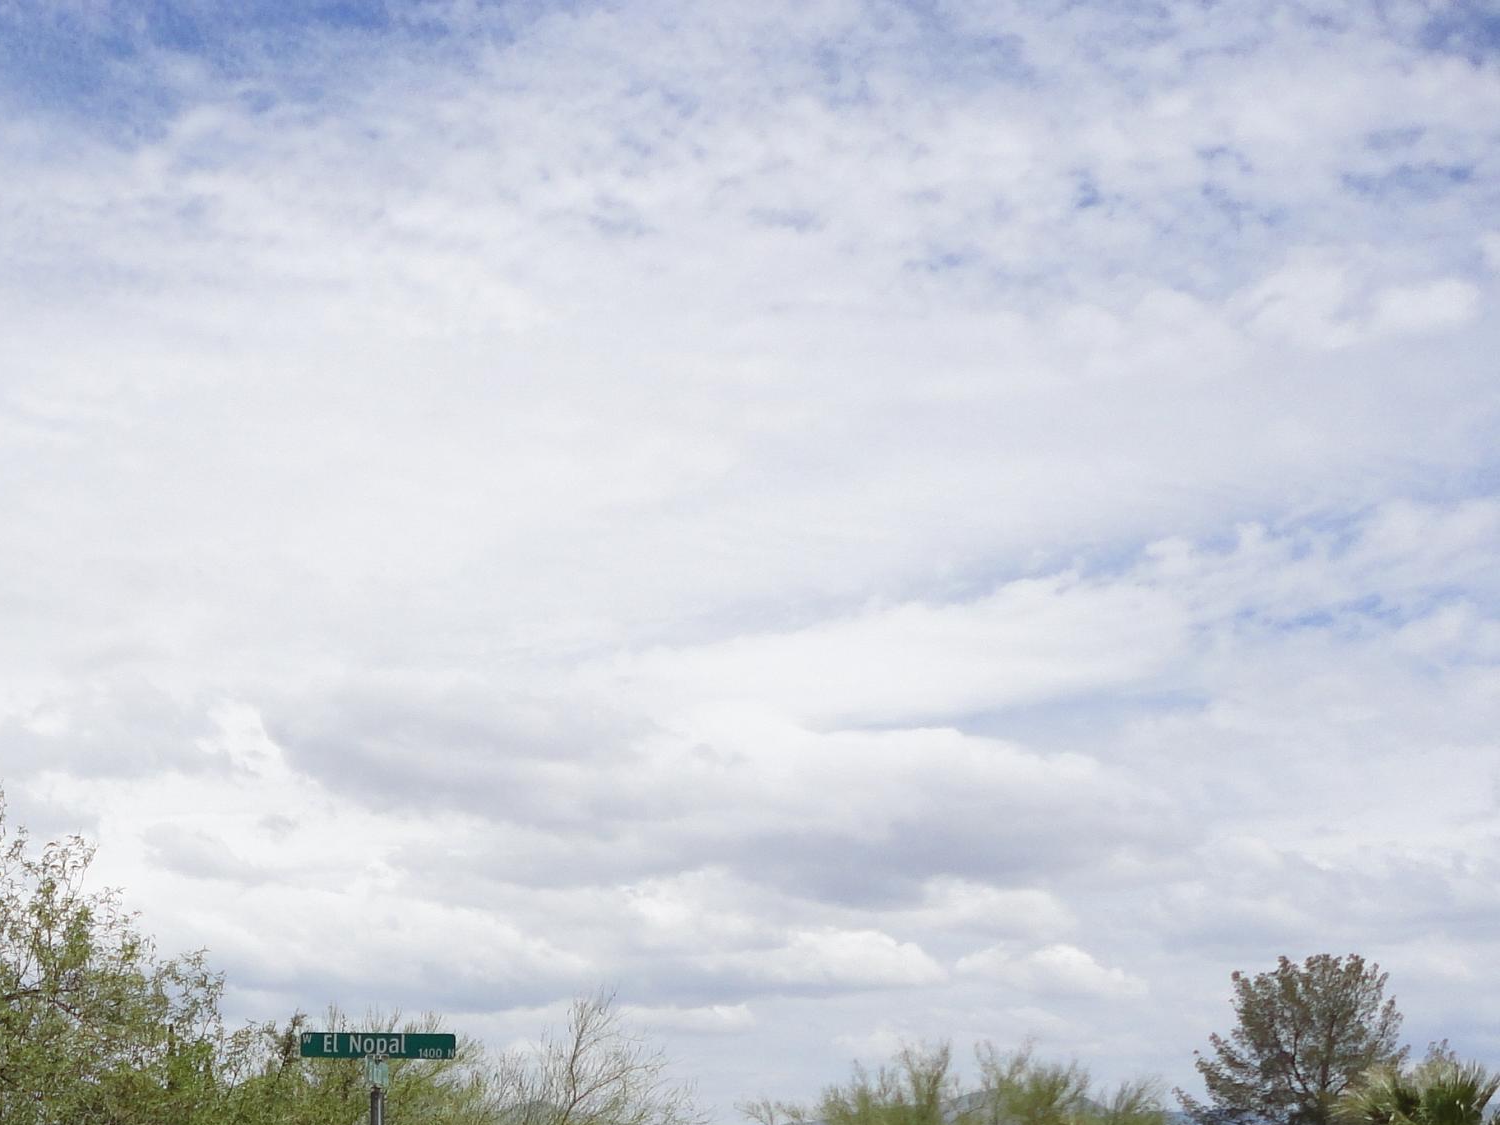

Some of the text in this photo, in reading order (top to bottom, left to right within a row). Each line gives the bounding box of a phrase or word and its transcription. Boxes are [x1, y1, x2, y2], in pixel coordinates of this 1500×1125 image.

[302, 1033, 312, 1044] W
[323, 1033, 407, 1055] El Nopal
[418, 1048, 455, 1059] 1400 N
